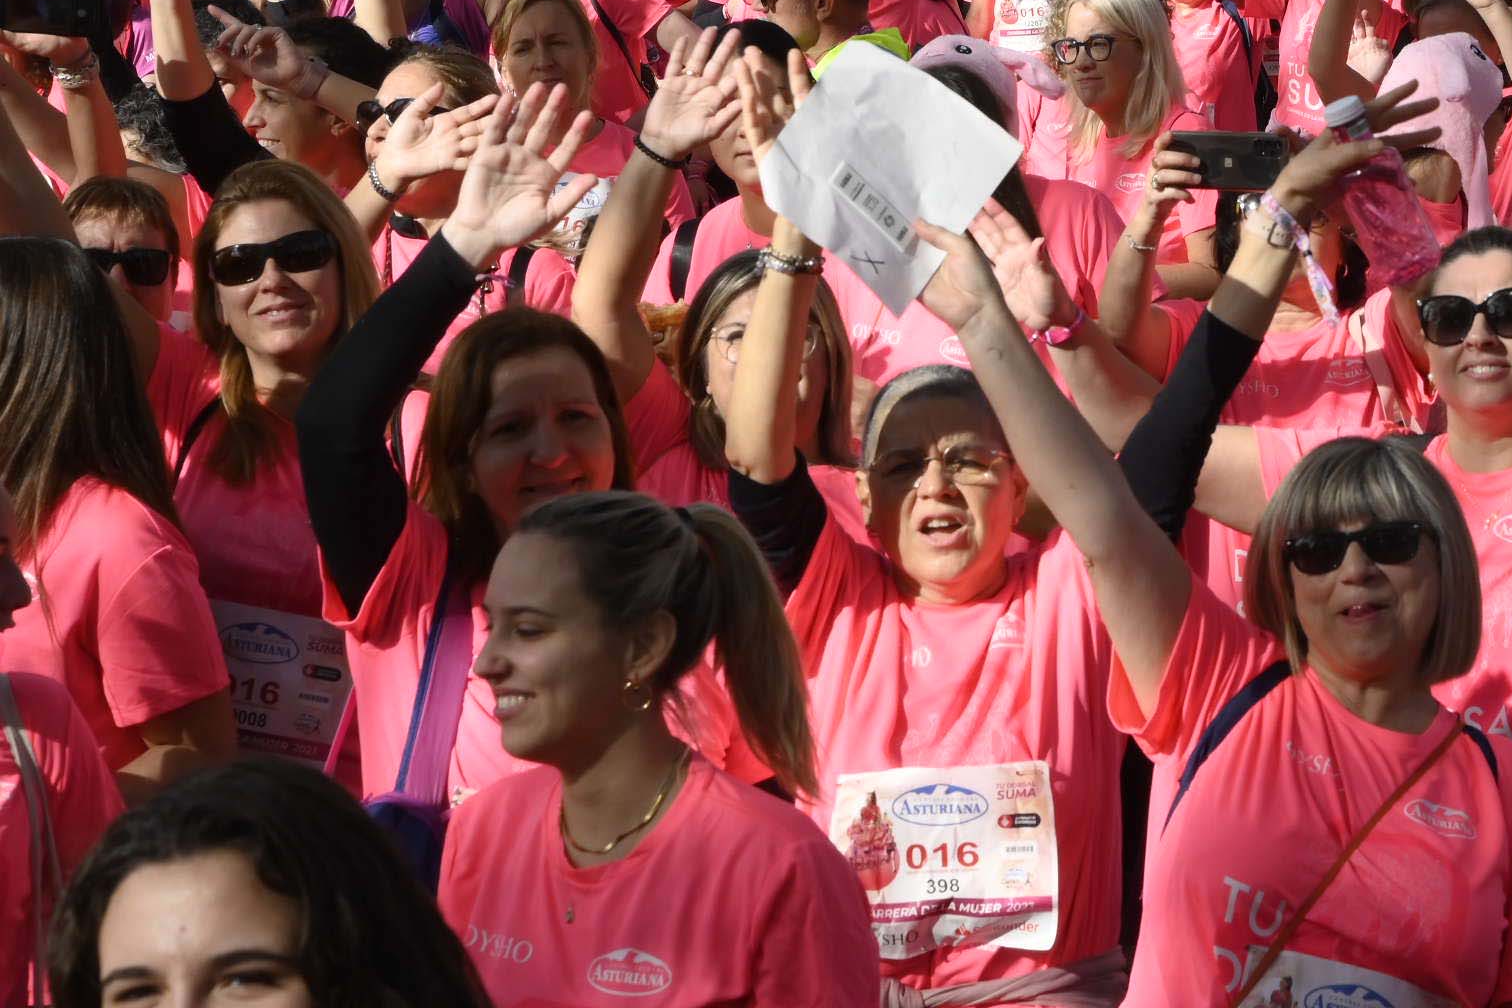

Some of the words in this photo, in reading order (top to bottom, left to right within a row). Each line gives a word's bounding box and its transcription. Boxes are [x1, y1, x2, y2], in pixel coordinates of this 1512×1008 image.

[1020, 6, 1045, 18] 016
[1288, 62, 1305, 78] TU
[1287, 79, 1322, 111] SU
[233, 708, 267, 728] 008
[996, 789, 1037, 801] SUMA
[900, 799, 983, 817] ASTURIANA
[905, 841, 980, 870] 016
[925, 878, 960, 895] 398
[958, 900, 1003, 914] MUJER
[1223, 875, 1287, 938] TU
[592, 964, 667, 988] ASTURIANA
